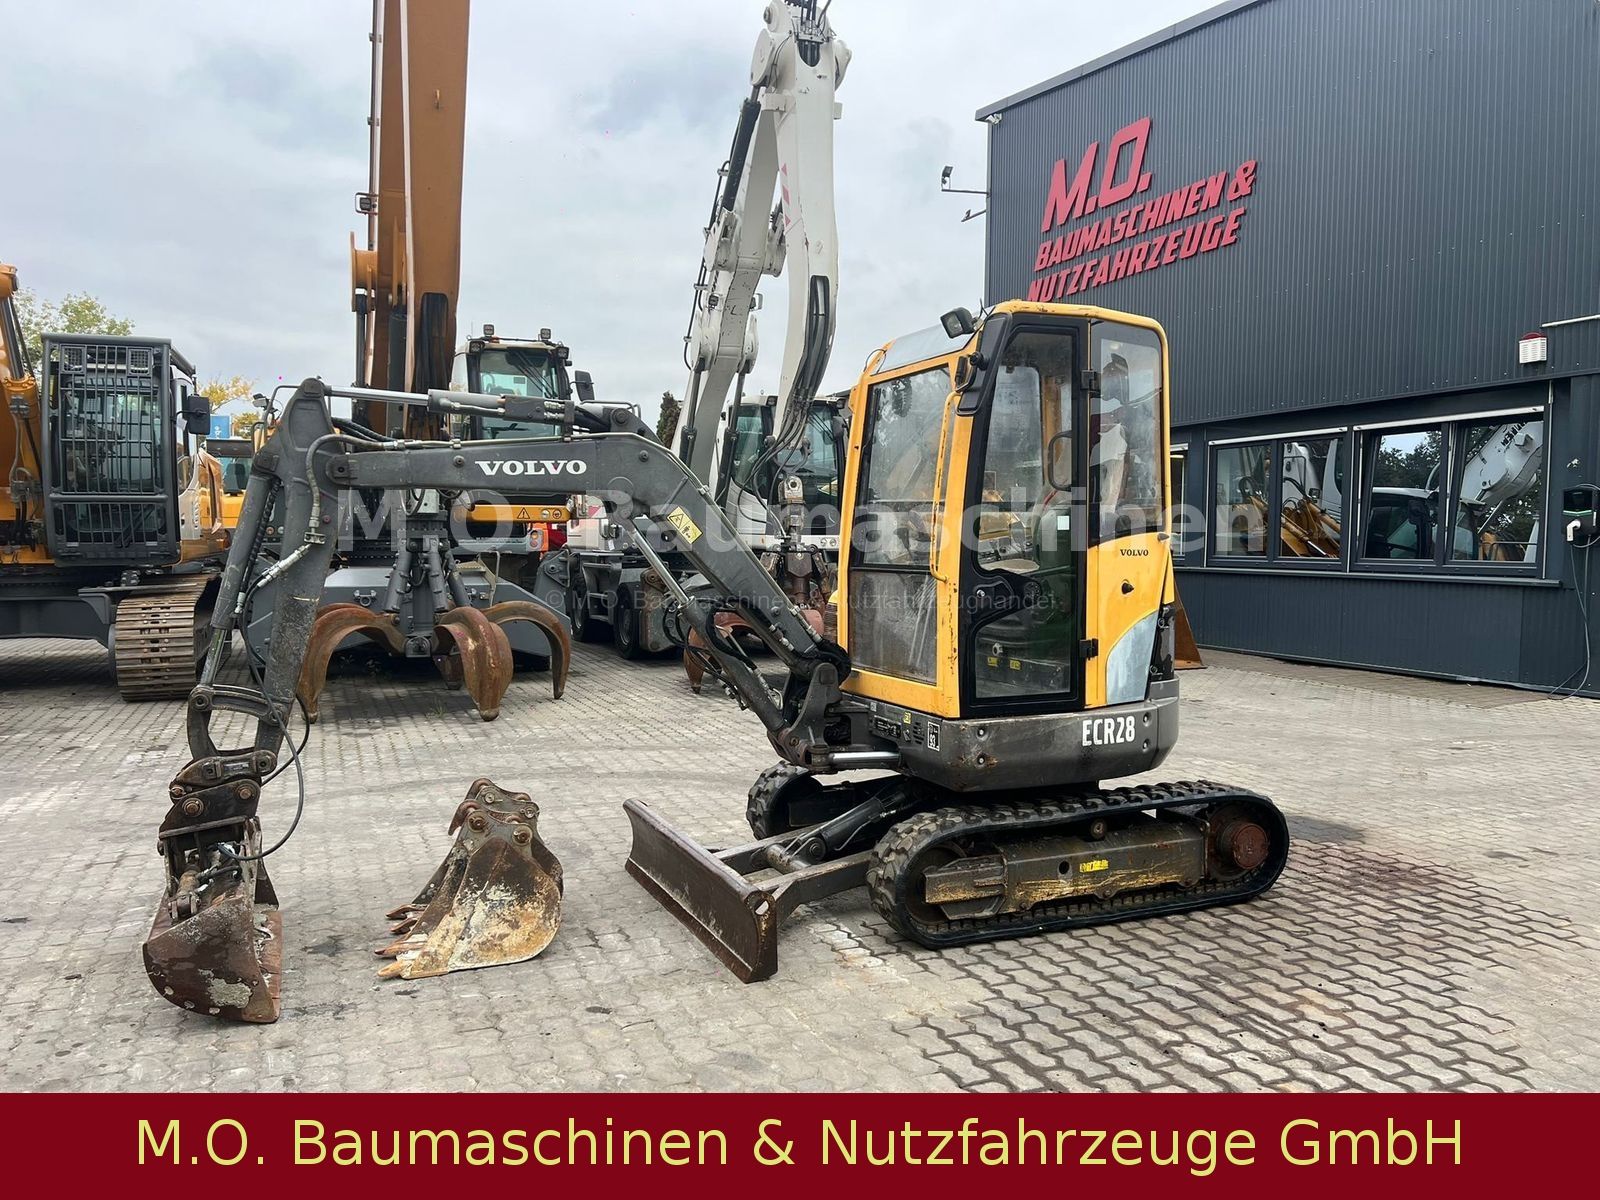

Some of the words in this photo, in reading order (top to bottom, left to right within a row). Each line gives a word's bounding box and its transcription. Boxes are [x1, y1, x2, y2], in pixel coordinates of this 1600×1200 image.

[1034, 171, 1228, 272] BAUMASCHINEN
[1227, 160, 1257, 201] &
[1041, 116, 1151, 232] M.O.
[1026, 207, 1245, 302] NUTZFAHRZEUGE
[475, 460, 588, 476] VOLVO
[1081, 715, 1136, 747] ECR28
